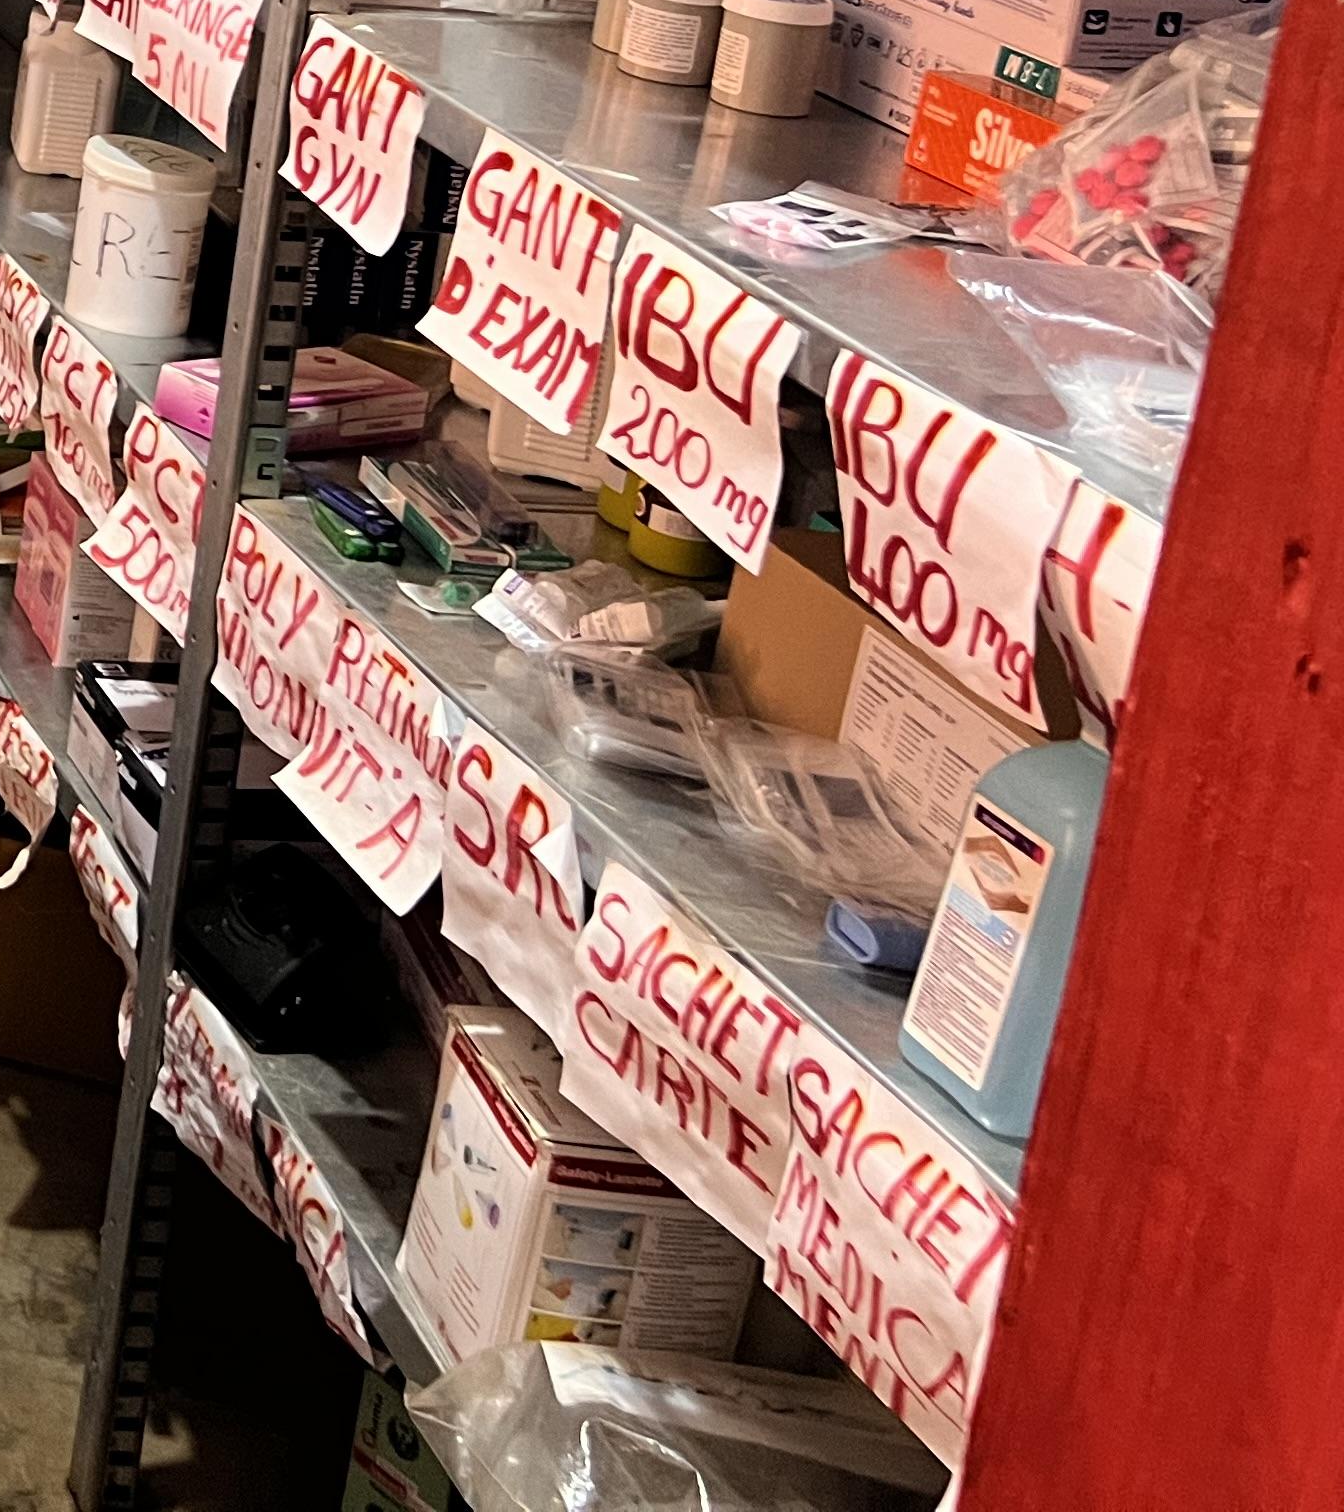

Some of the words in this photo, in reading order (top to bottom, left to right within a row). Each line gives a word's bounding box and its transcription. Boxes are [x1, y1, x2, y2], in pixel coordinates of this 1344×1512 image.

[145, 33, 168, 90] 5
[292, 36, 426, 154] GANT
[293, 128, 383, 227] GYN
[466, 150, 622, 296] GANT
[400, 240, 424, 309] Nystatin
[45, 324, 116, 425] PCT
[615, 252, 786, 426] IBU
[130, 416, 207, 524] PCT
[609, 384, 713, 491] 200
[714, 477, 768, 554] mg
[832, 353, 996, 555] IBU
[91, 504, 176, 606] 500
[226, 514, 319, 650] POLY
[967, 606, 1035, 715] mg
[585, 892, 801, 1097] SACHET
[575, 990, 775, 1197] CARTE
[790, 1056, 1017, 1304] SACHET
